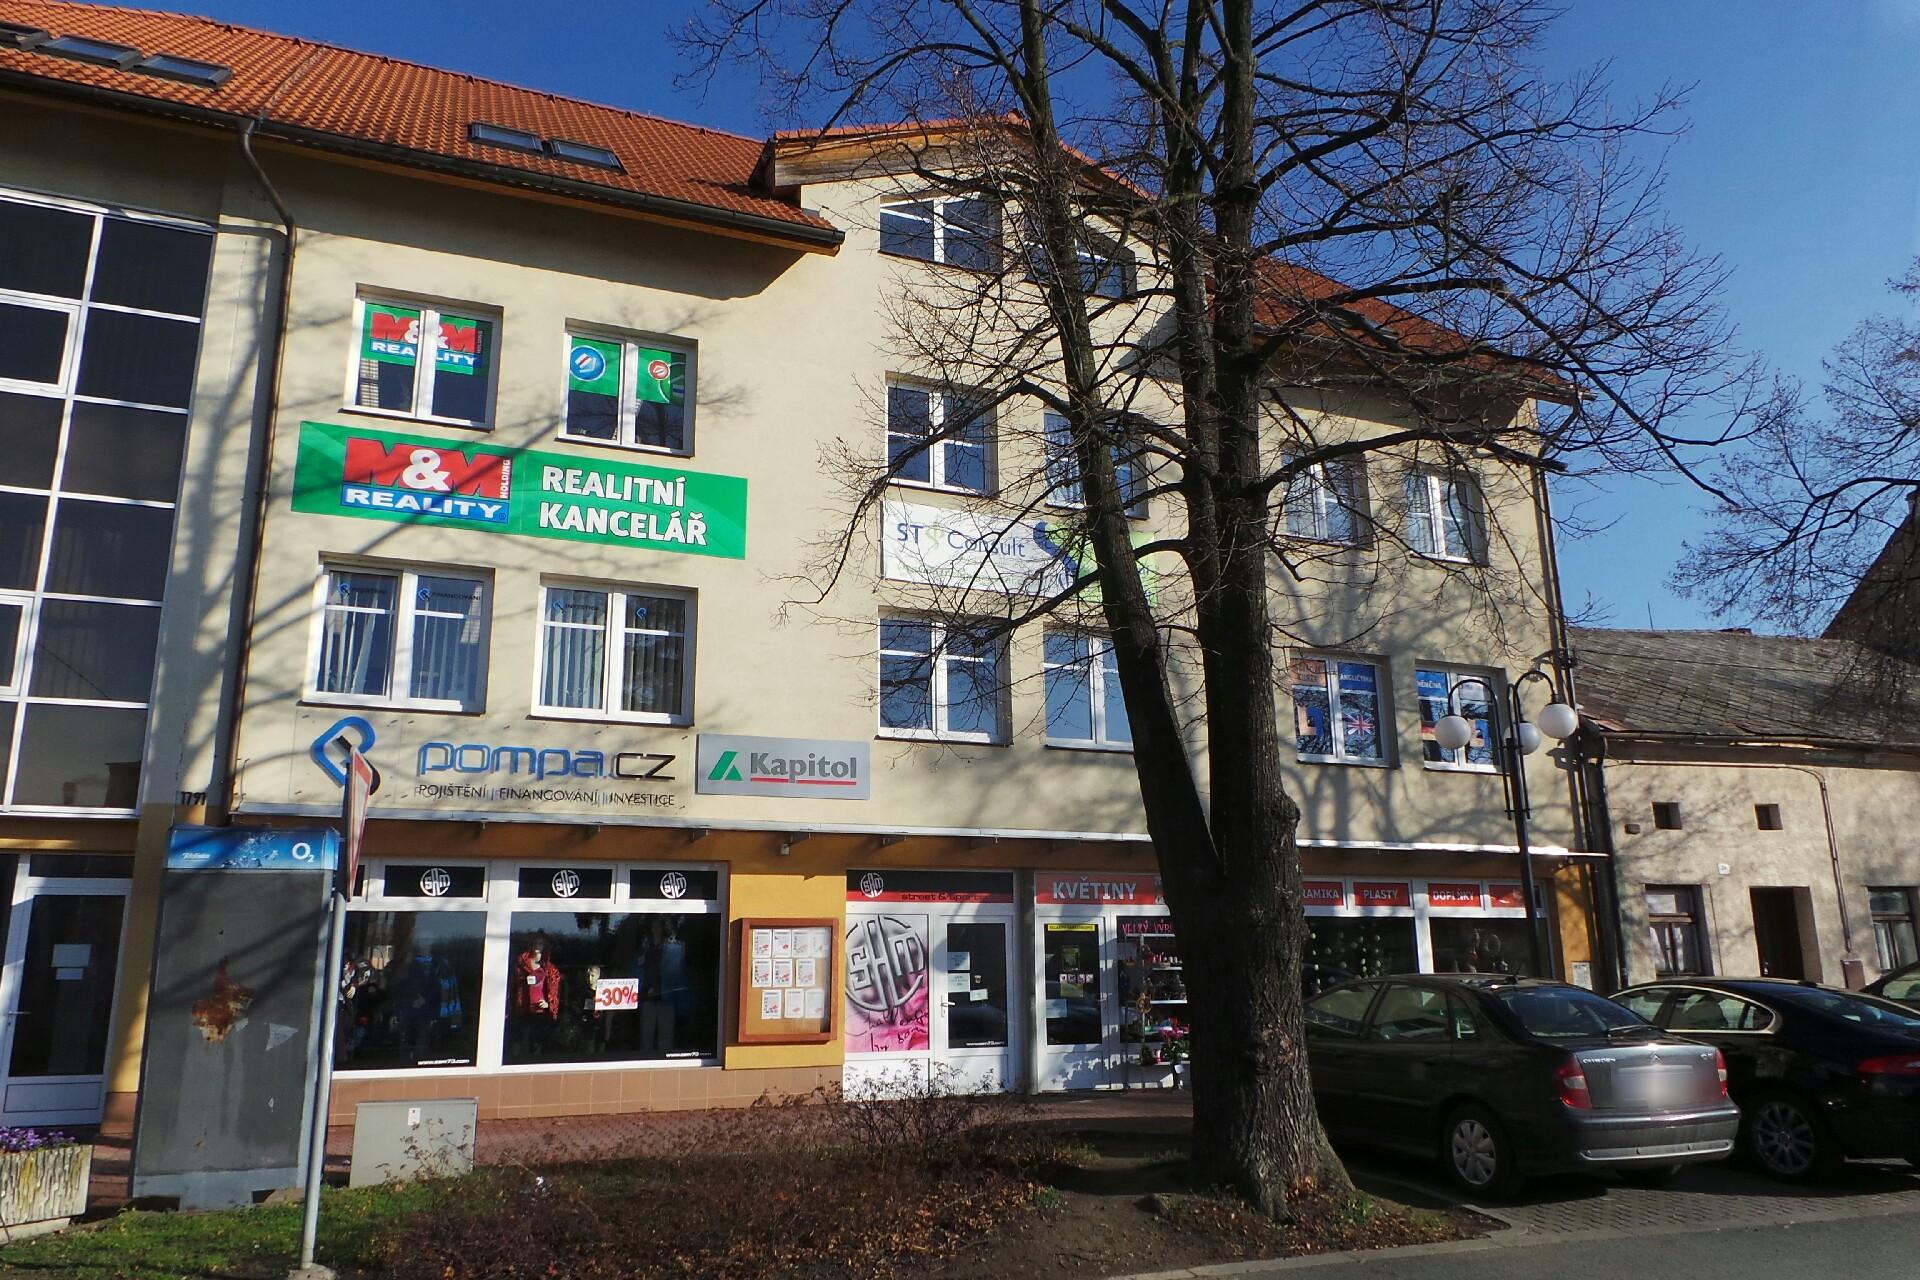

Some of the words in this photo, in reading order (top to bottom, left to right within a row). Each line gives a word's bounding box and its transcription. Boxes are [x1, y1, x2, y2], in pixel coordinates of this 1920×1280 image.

[343, 437, 504, 499] M&M
[499, 459, 511, 499] HOLDING
[542, 466, 687, 507] REALITNÍ
[345, 488, 502, 519] REALITY
[539, 501, 708, 546] KANCELÁŘ
[947, 530, 1026, 558] Consult
[751, 752, 857, 784] Kapitol
[418, 783, 487, 799] POJIŠTĚNÍ
[500, 787, 598, 803] FINANCOVÁNÍ
[609, 792, 675, 807] INVESTICE
[1053, 876, 1137, 900] KVĚTINY
[1363, 889, 1398, 899] PLASTY
[1432, 887, 1474, 901] DOPLŇKY
[596, 985, 640, 1007] -30%
